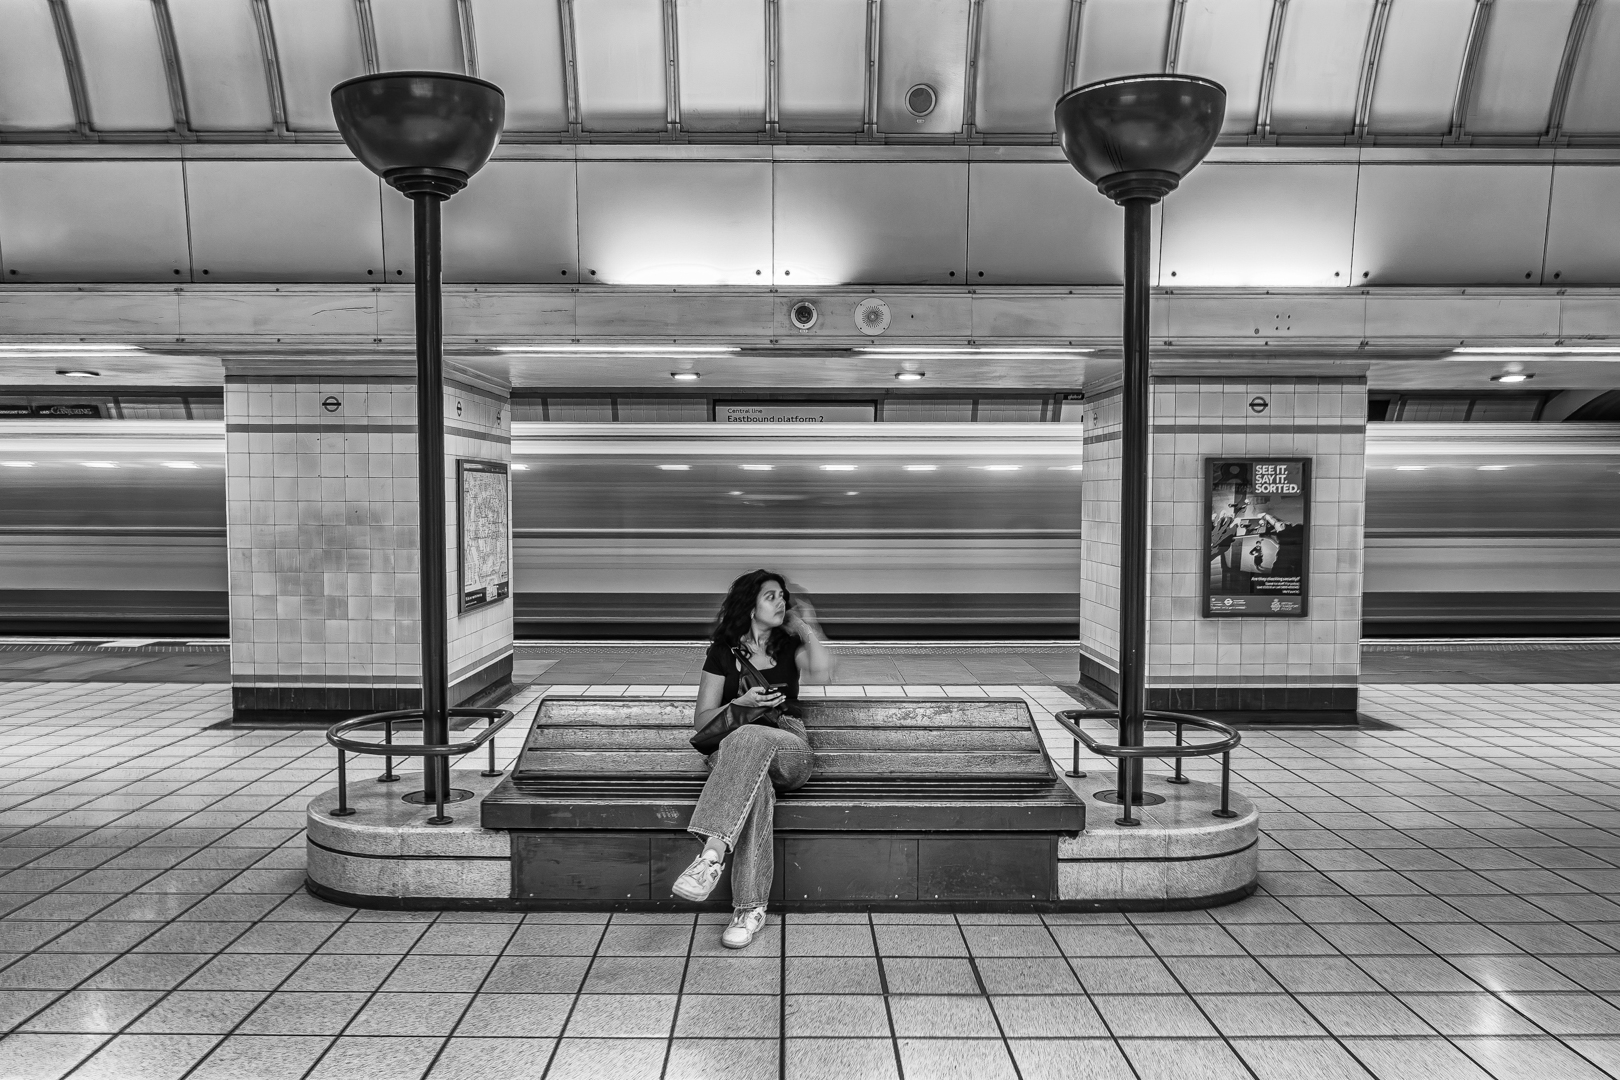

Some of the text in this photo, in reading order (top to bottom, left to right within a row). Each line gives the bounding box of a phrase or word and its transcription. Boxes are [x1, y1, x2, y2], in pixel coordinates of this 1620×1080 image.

[1255, 465, 1275, 475] SEE
[1255, 474, 1288, 484] SAY IT.
[1255, 483, 1300, 493] SORTED.
